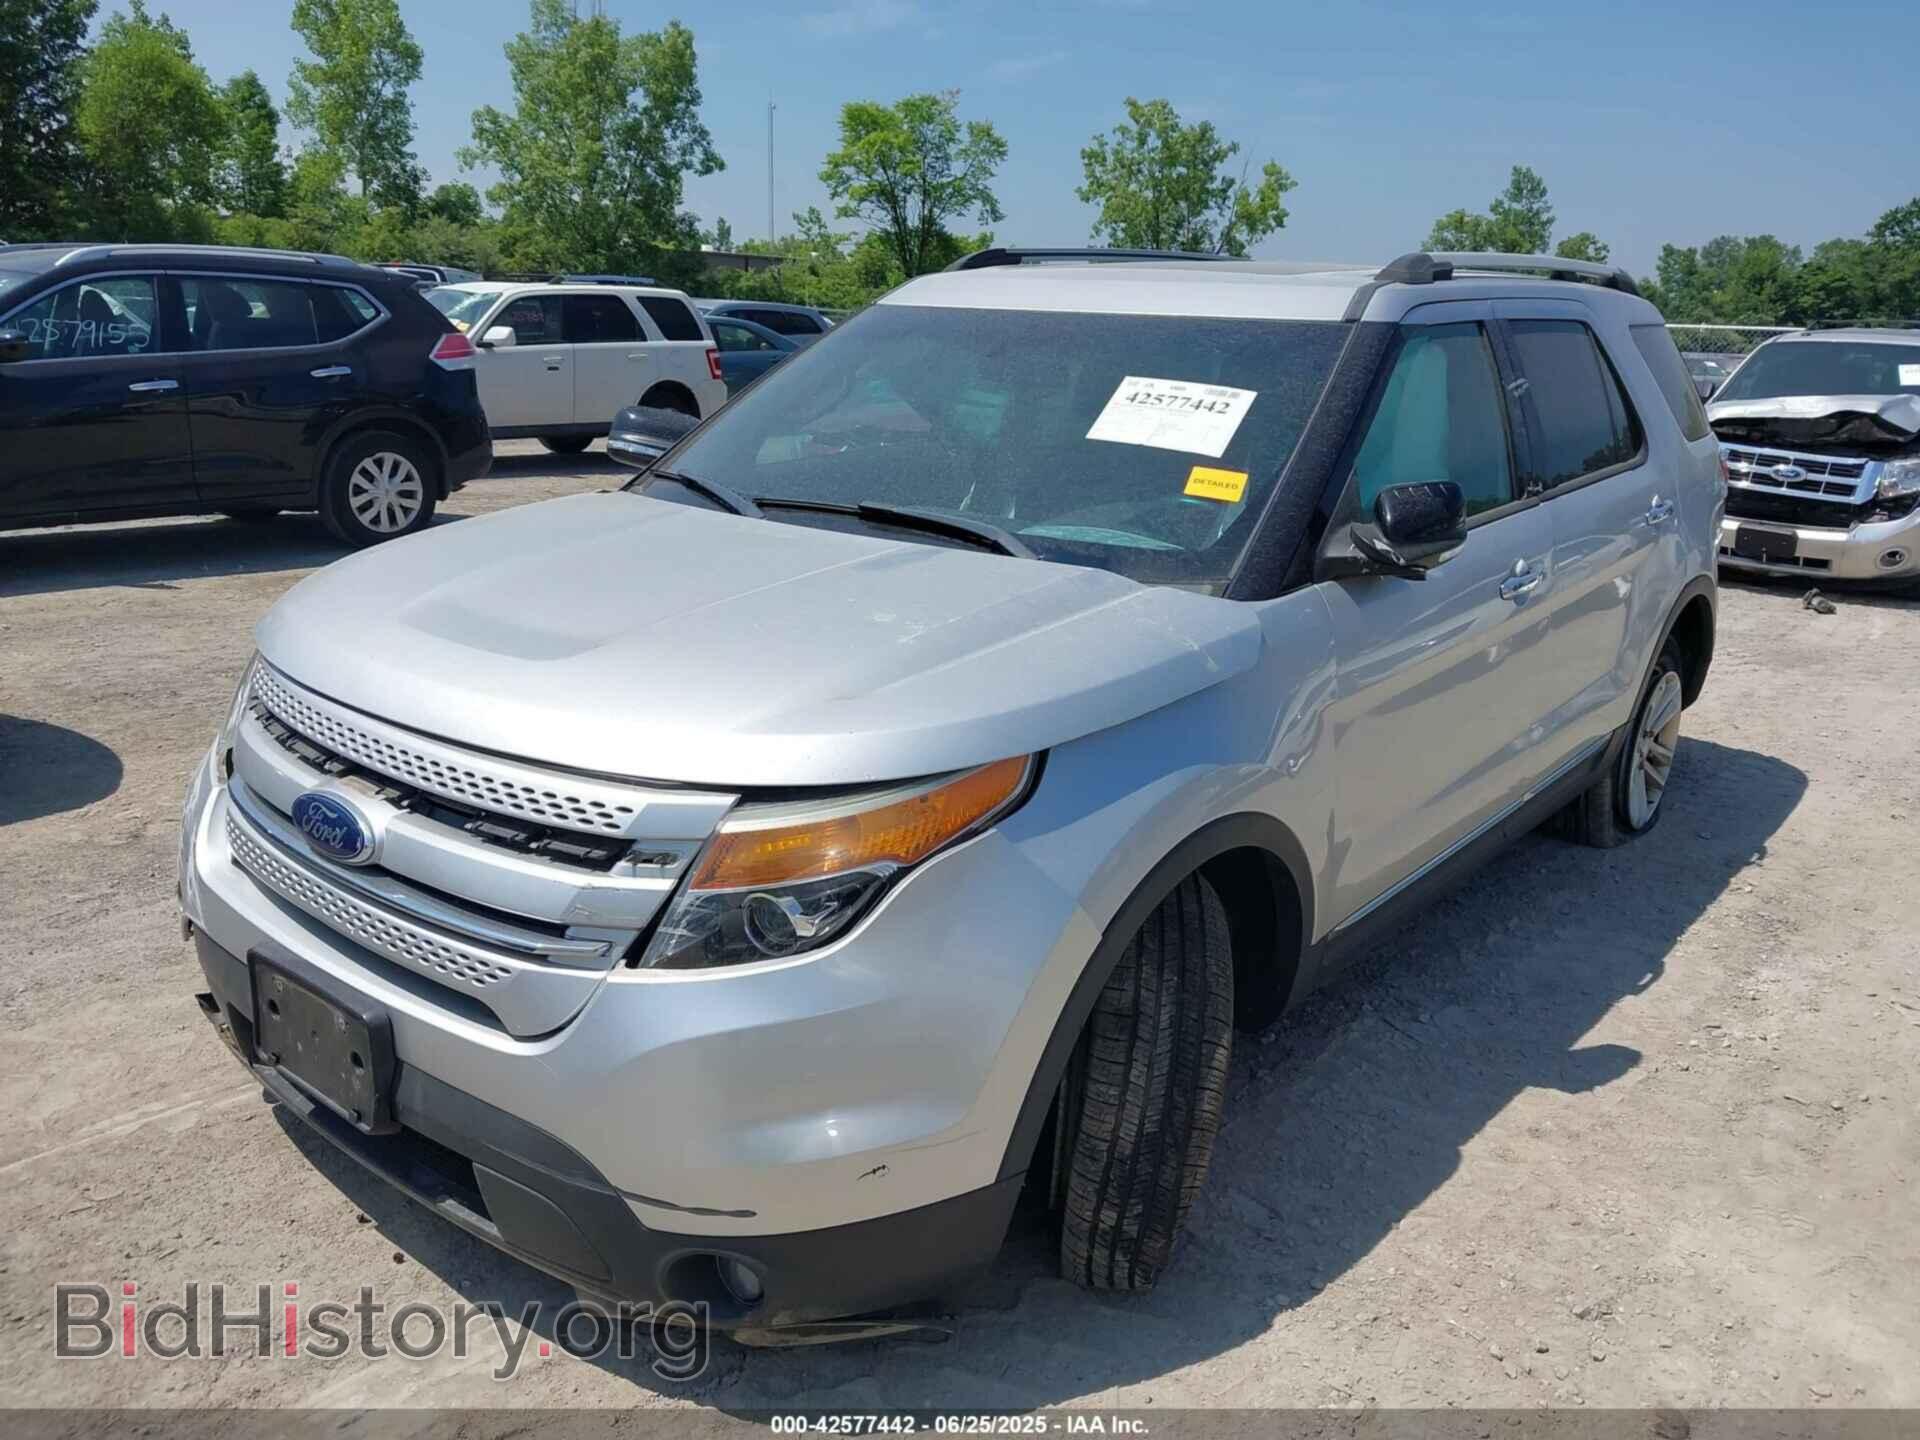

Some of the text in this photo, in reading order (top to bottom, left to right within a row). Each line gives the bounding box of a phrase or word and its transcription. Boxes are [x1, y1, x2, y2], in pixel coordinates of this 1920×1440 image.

[1125, 391, 1231, 415] 42577442
[1193, 478, 1239, 490] DETAILED
[302, 801, 347, 849] Ford
